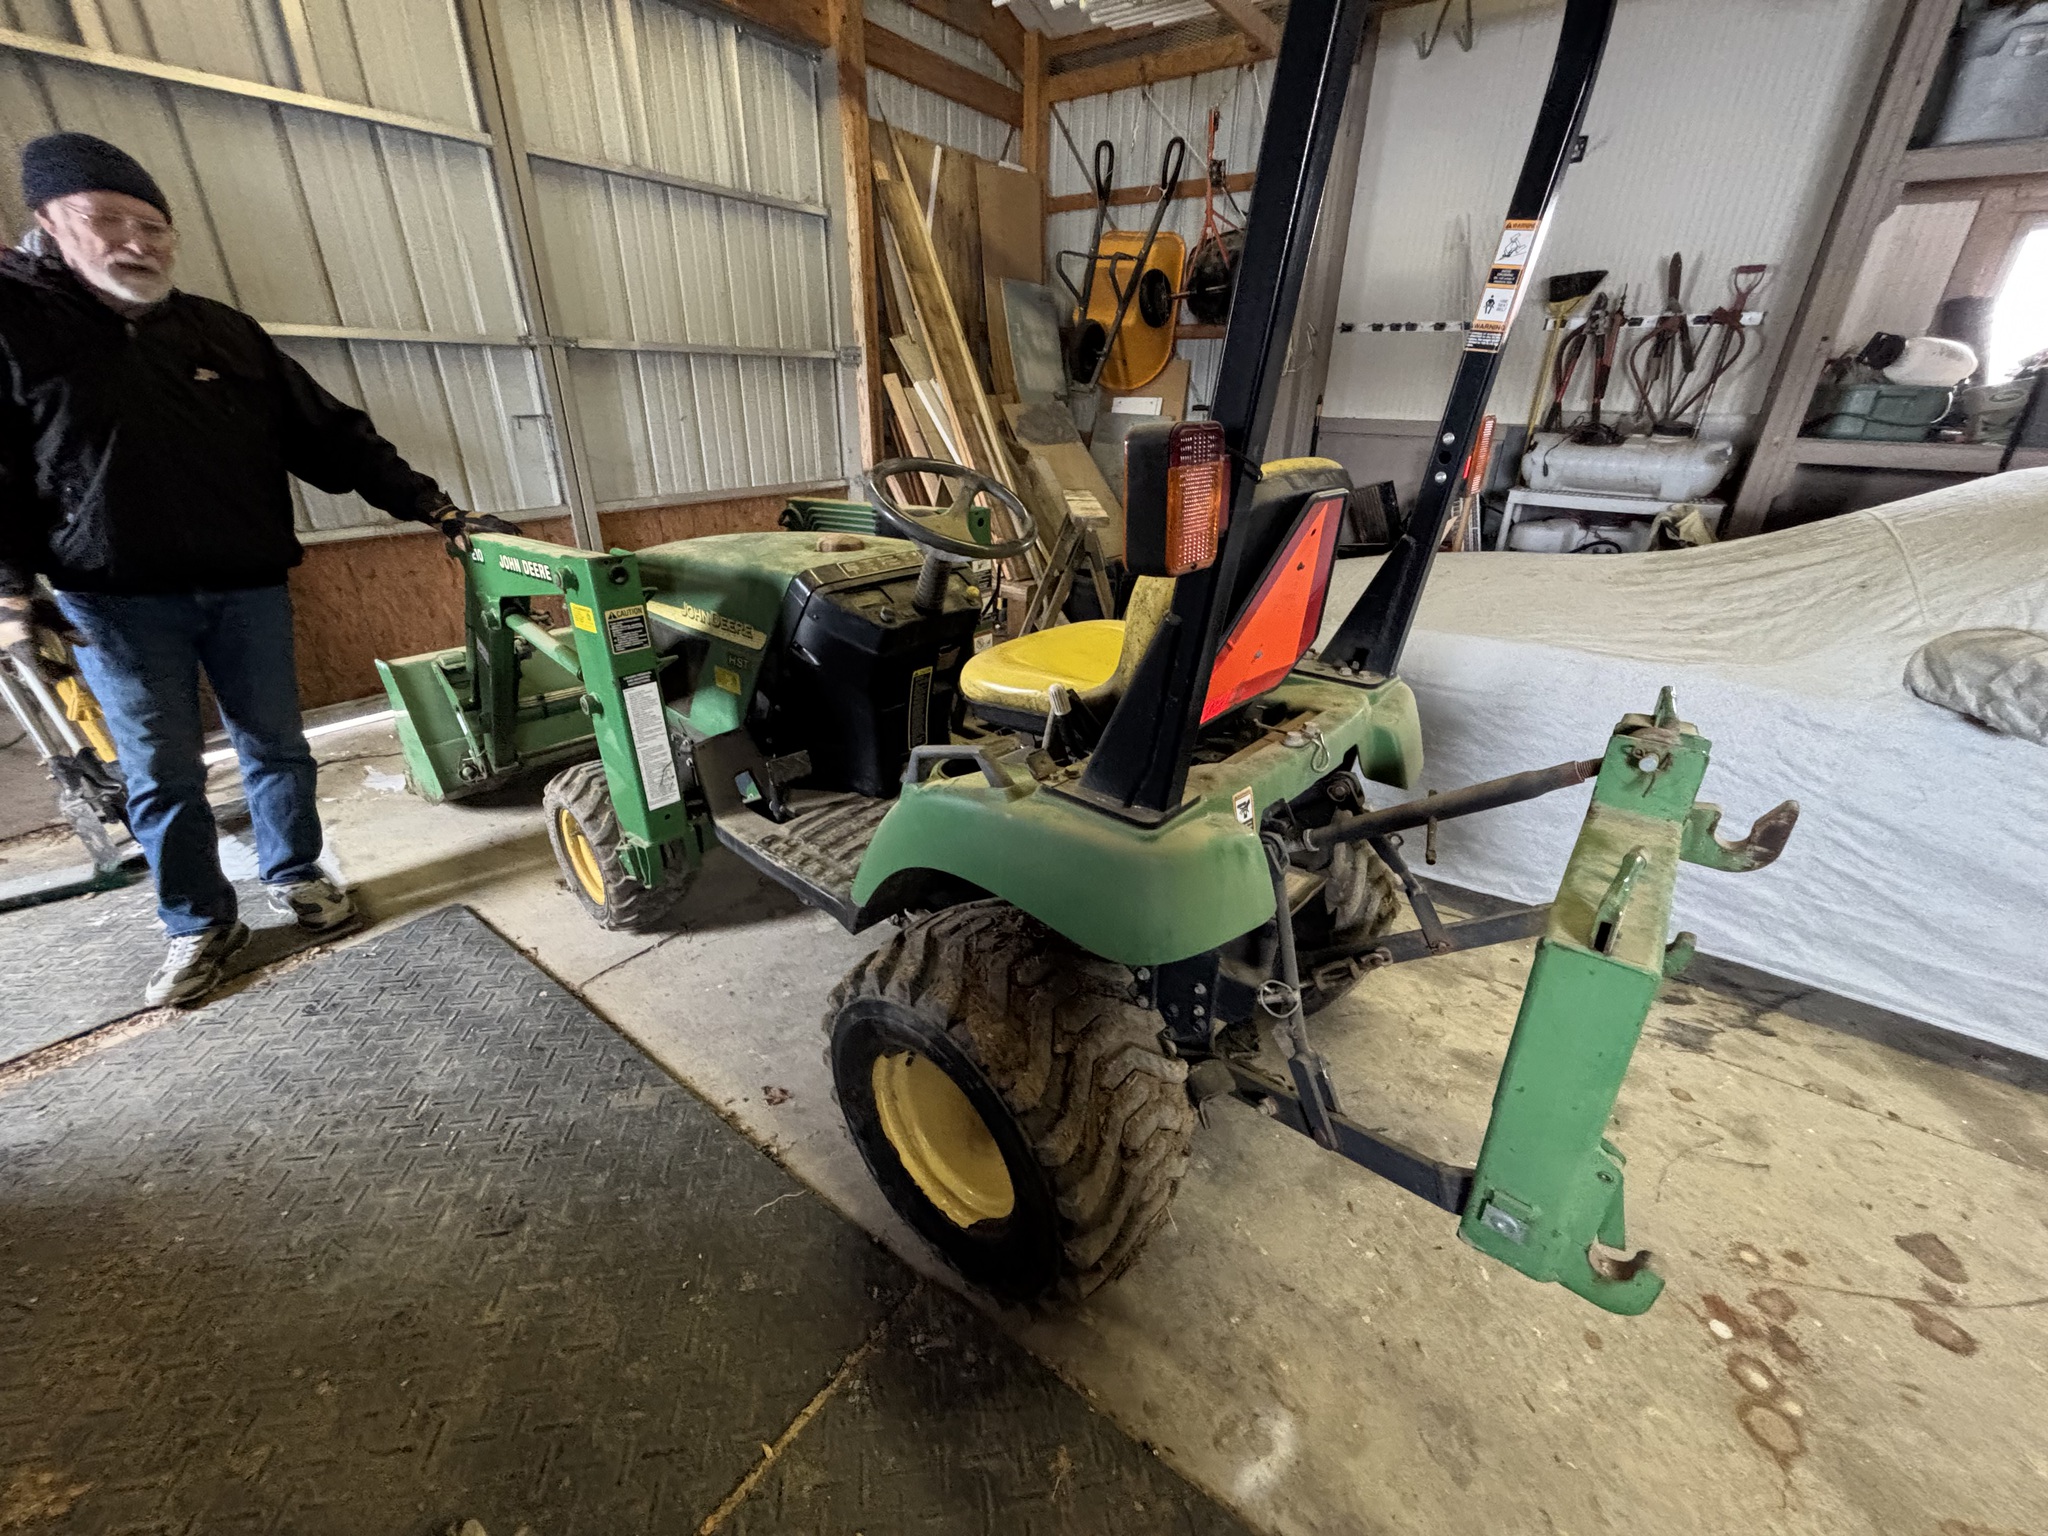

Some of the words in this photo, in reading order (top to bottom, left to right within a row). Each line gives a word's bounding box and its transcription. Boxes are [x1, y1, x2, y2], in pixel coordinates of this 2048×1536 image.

[1474, 323, 1506, 331] WARNING
[499, 554, 522, 573] JOHN
[521, 559, 553, 582] DEERE
[616, 607, 643, 617] CAUTION
[681, 601, 711, 625] JOHN
[709, 609, 754, 640] DEERE
[728, 654, 749, 669] HST
